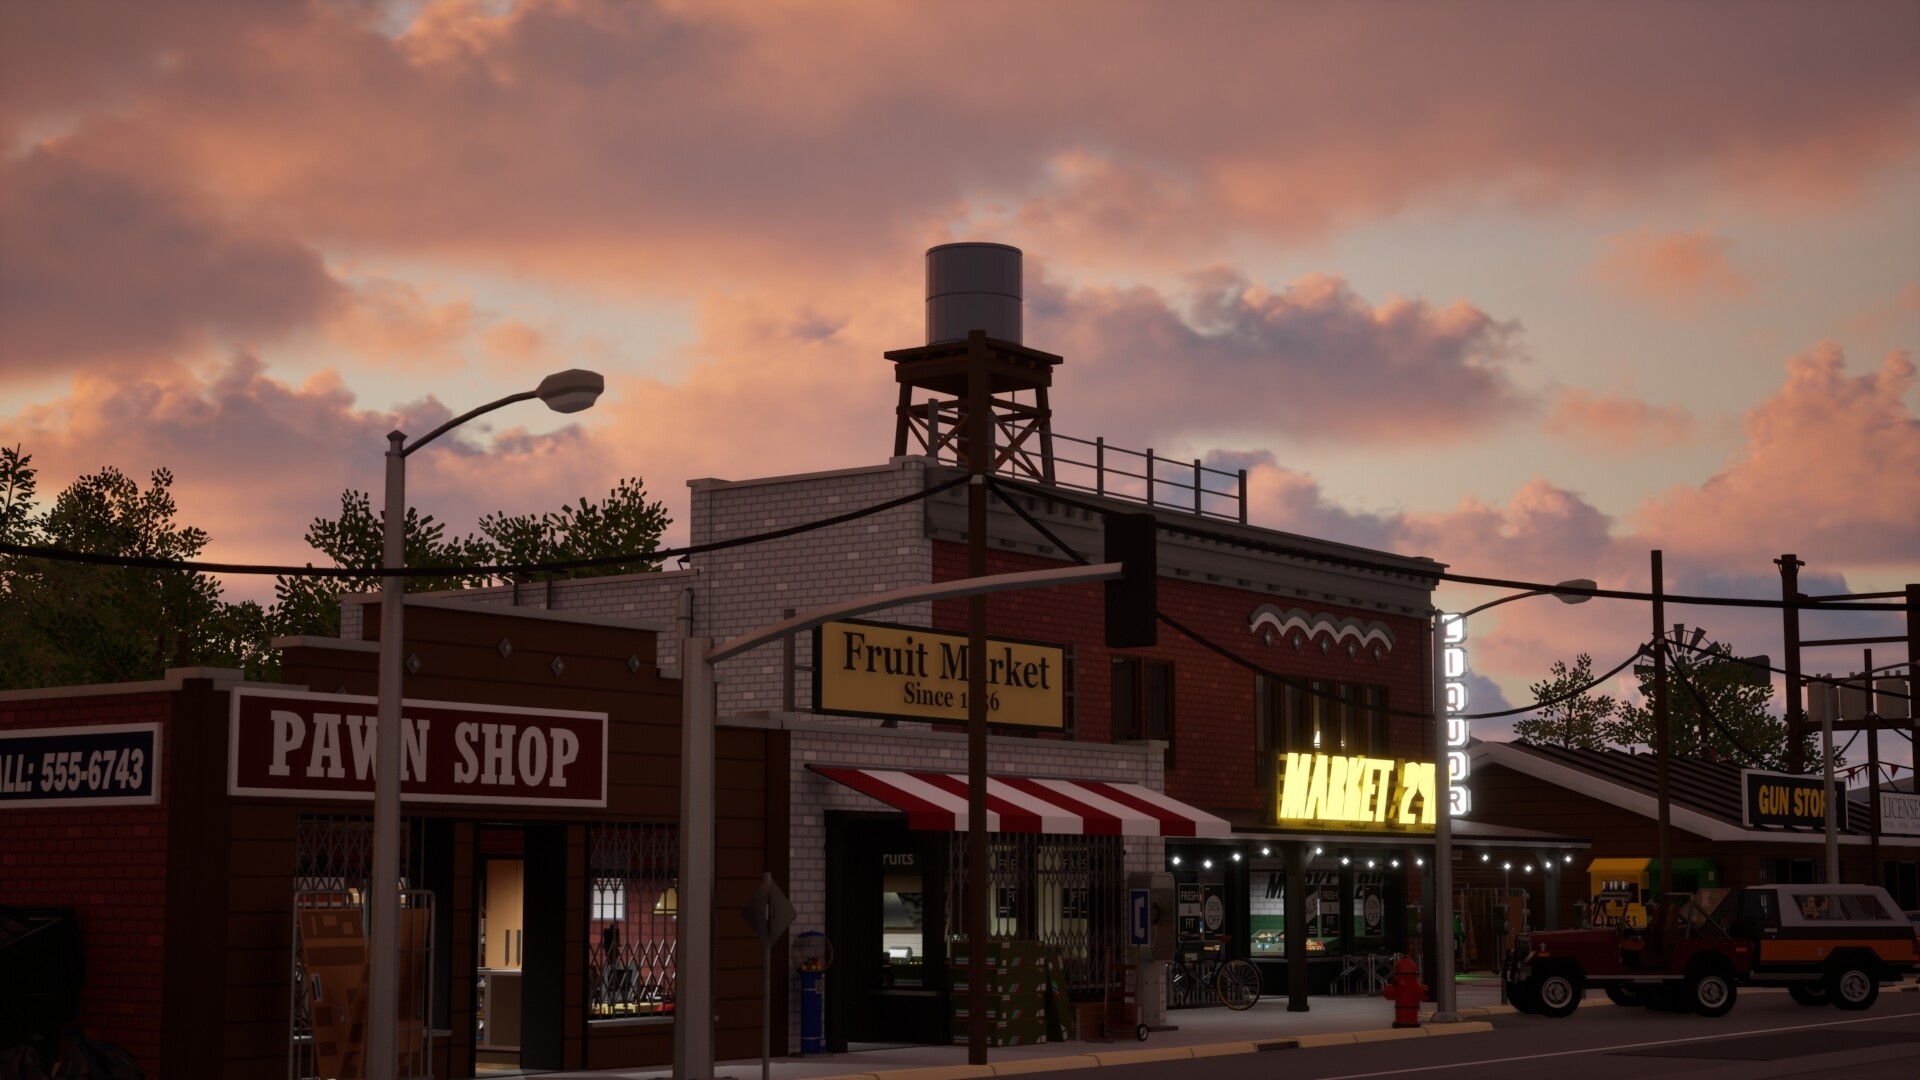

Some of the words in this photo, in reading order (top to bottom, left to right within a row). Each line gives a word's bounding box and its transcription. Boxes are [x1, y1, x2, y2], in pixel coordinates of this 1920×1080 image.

[843, 631, 929, 678] Fruit
[940, 642, 1050, 690] Mrket
[903, 682, 954, 707] Since
[960, 690, 1000, 714] 16
[268, 709, 431, 782] PAWN
[453, 721, 580, 788] SHOP
[0, 753, 34, 793] LL:
[40, 747, 145, 792] 555-6743
[1280, 752, 1395, 824] MARKET
[1758, 784, 1790, 816] GUN
[1793, 786, 1837, 818] STOR
[1883, 797, 1920, 820] LICENSE
[883, 853, 914, 865] ruits
[1181, 891, 1199, 901] FRESH
[1207, 914, 1221, 925] OFF
